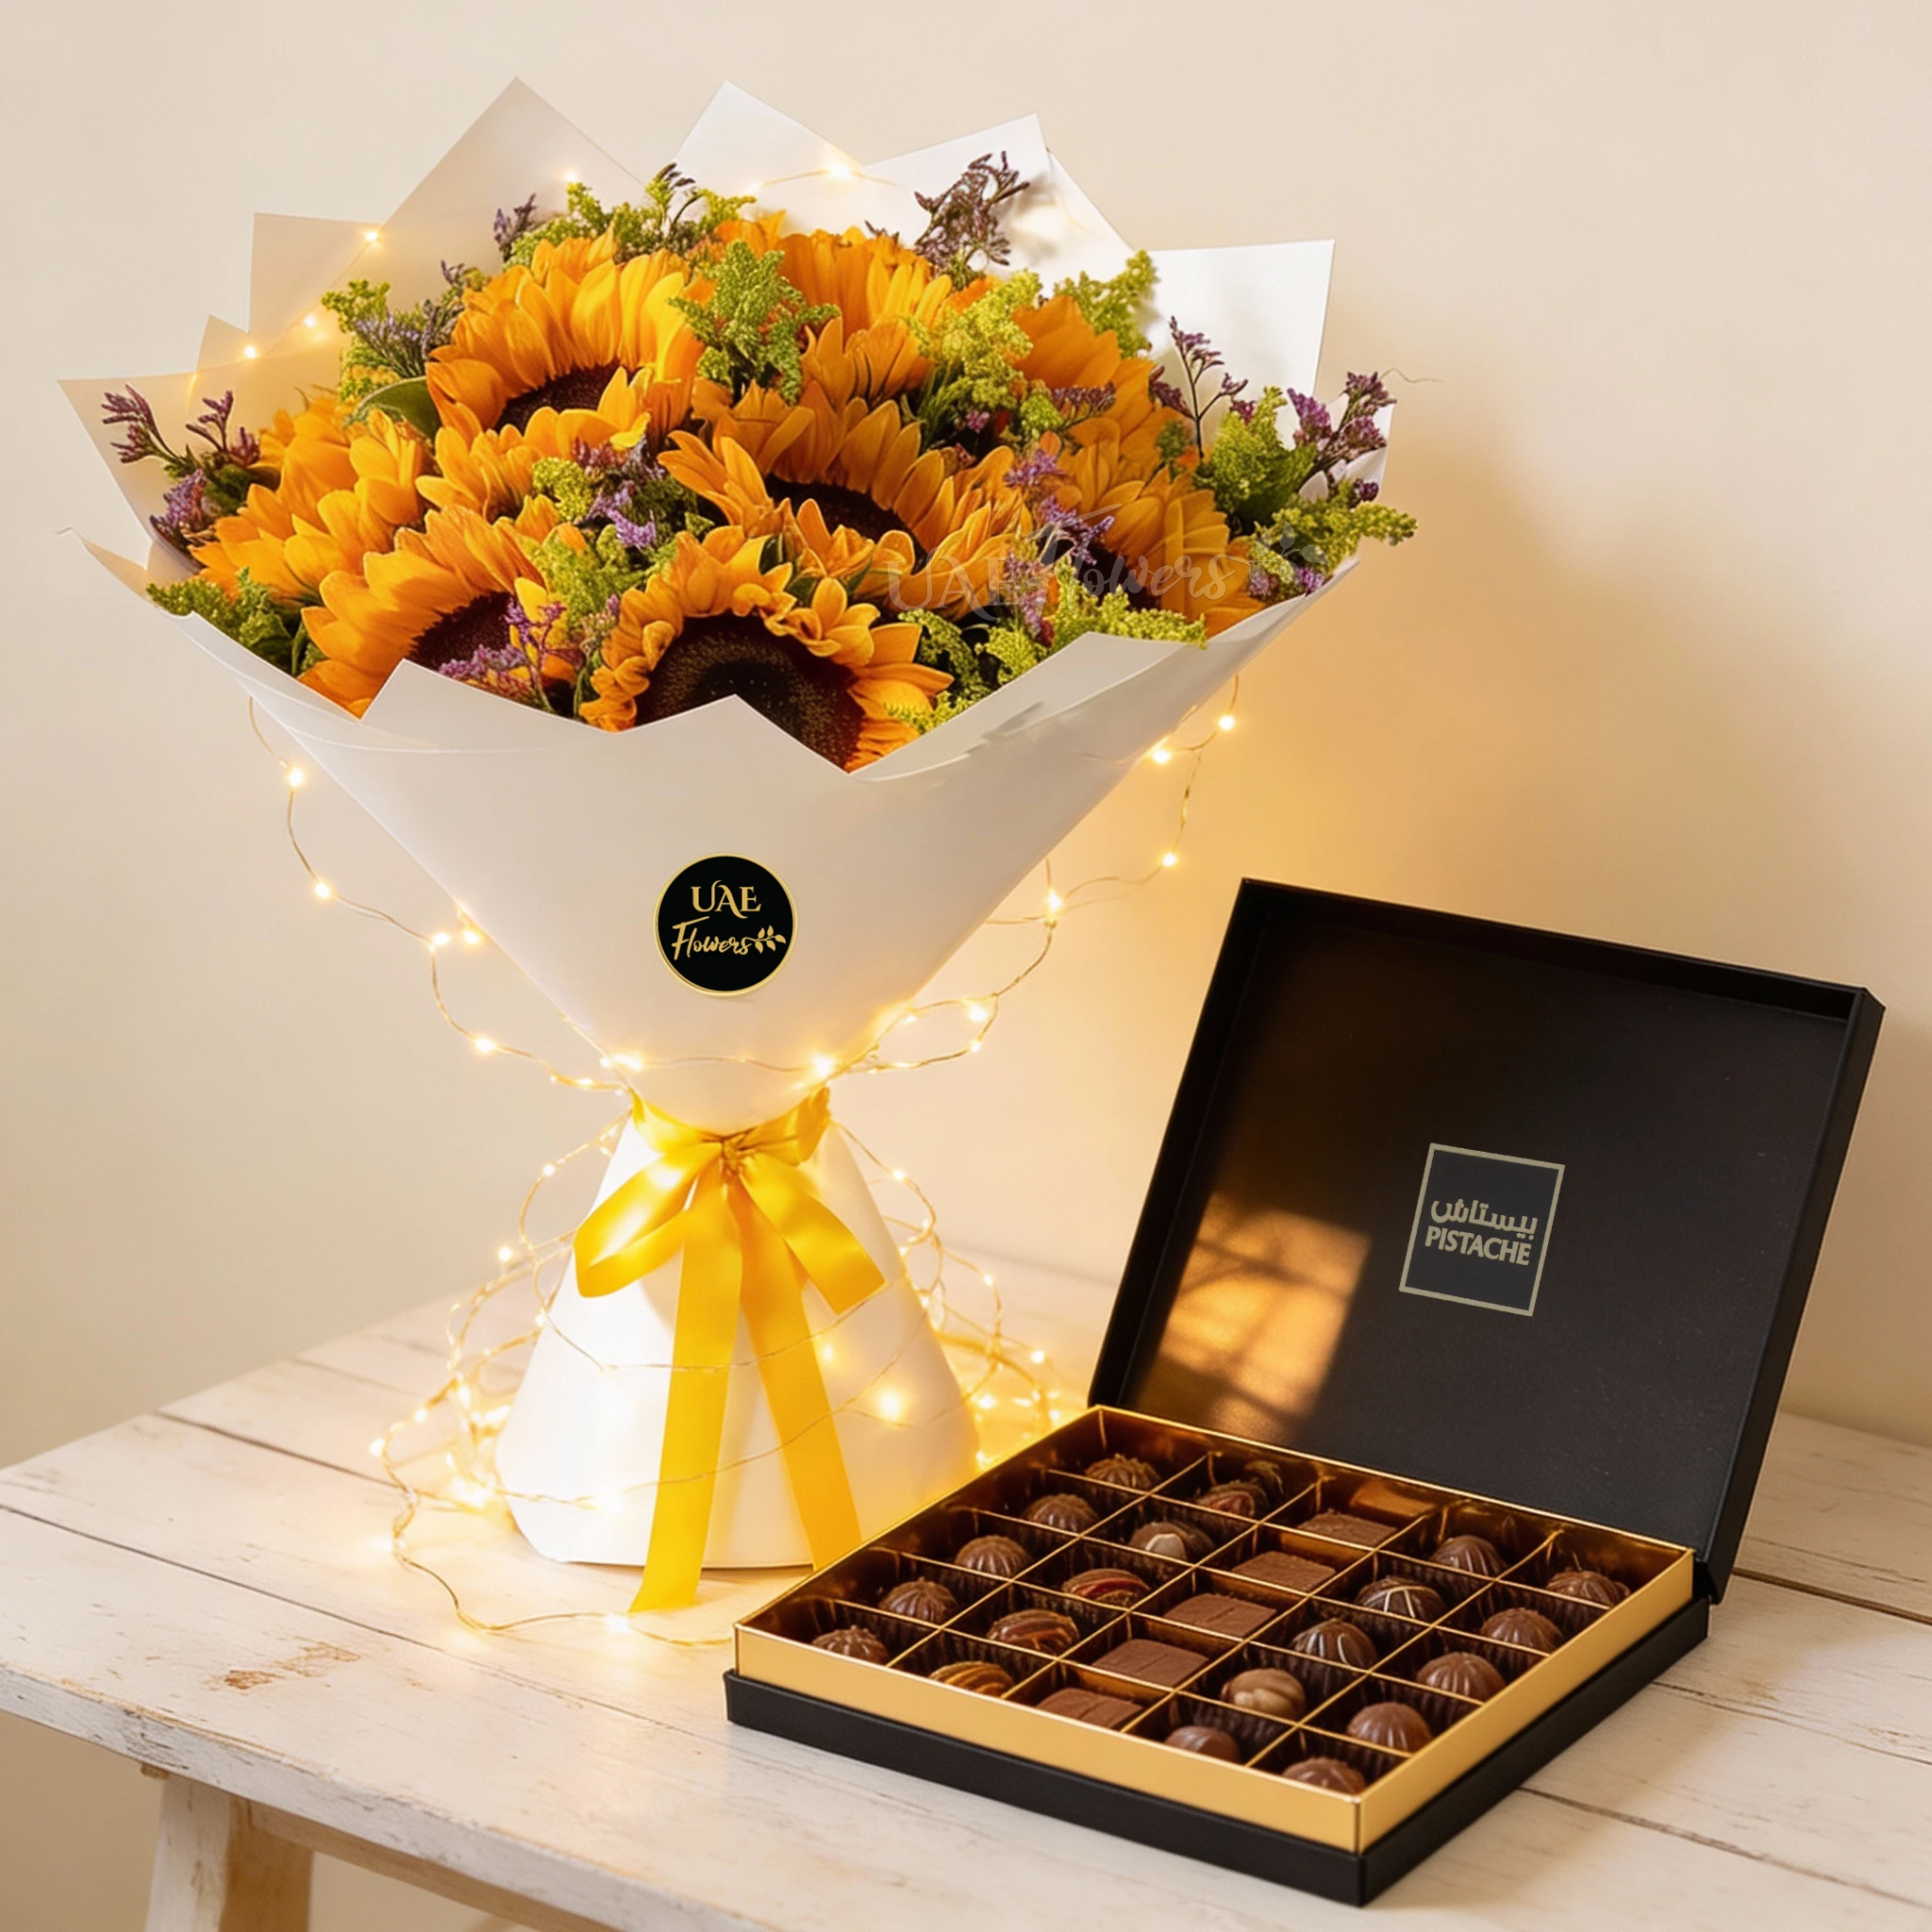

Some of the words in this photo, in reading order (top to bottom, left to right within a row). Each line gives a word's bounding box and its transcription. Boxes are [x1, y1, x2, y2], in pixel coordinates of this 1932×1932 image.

[690, 879, 762, 919] UAE
[671, 915, 753, 961] Flowers
[1430, 1198, 1538, 1241] بيستاش
[1424, 1224, 1532, 1266] PISTACHE
